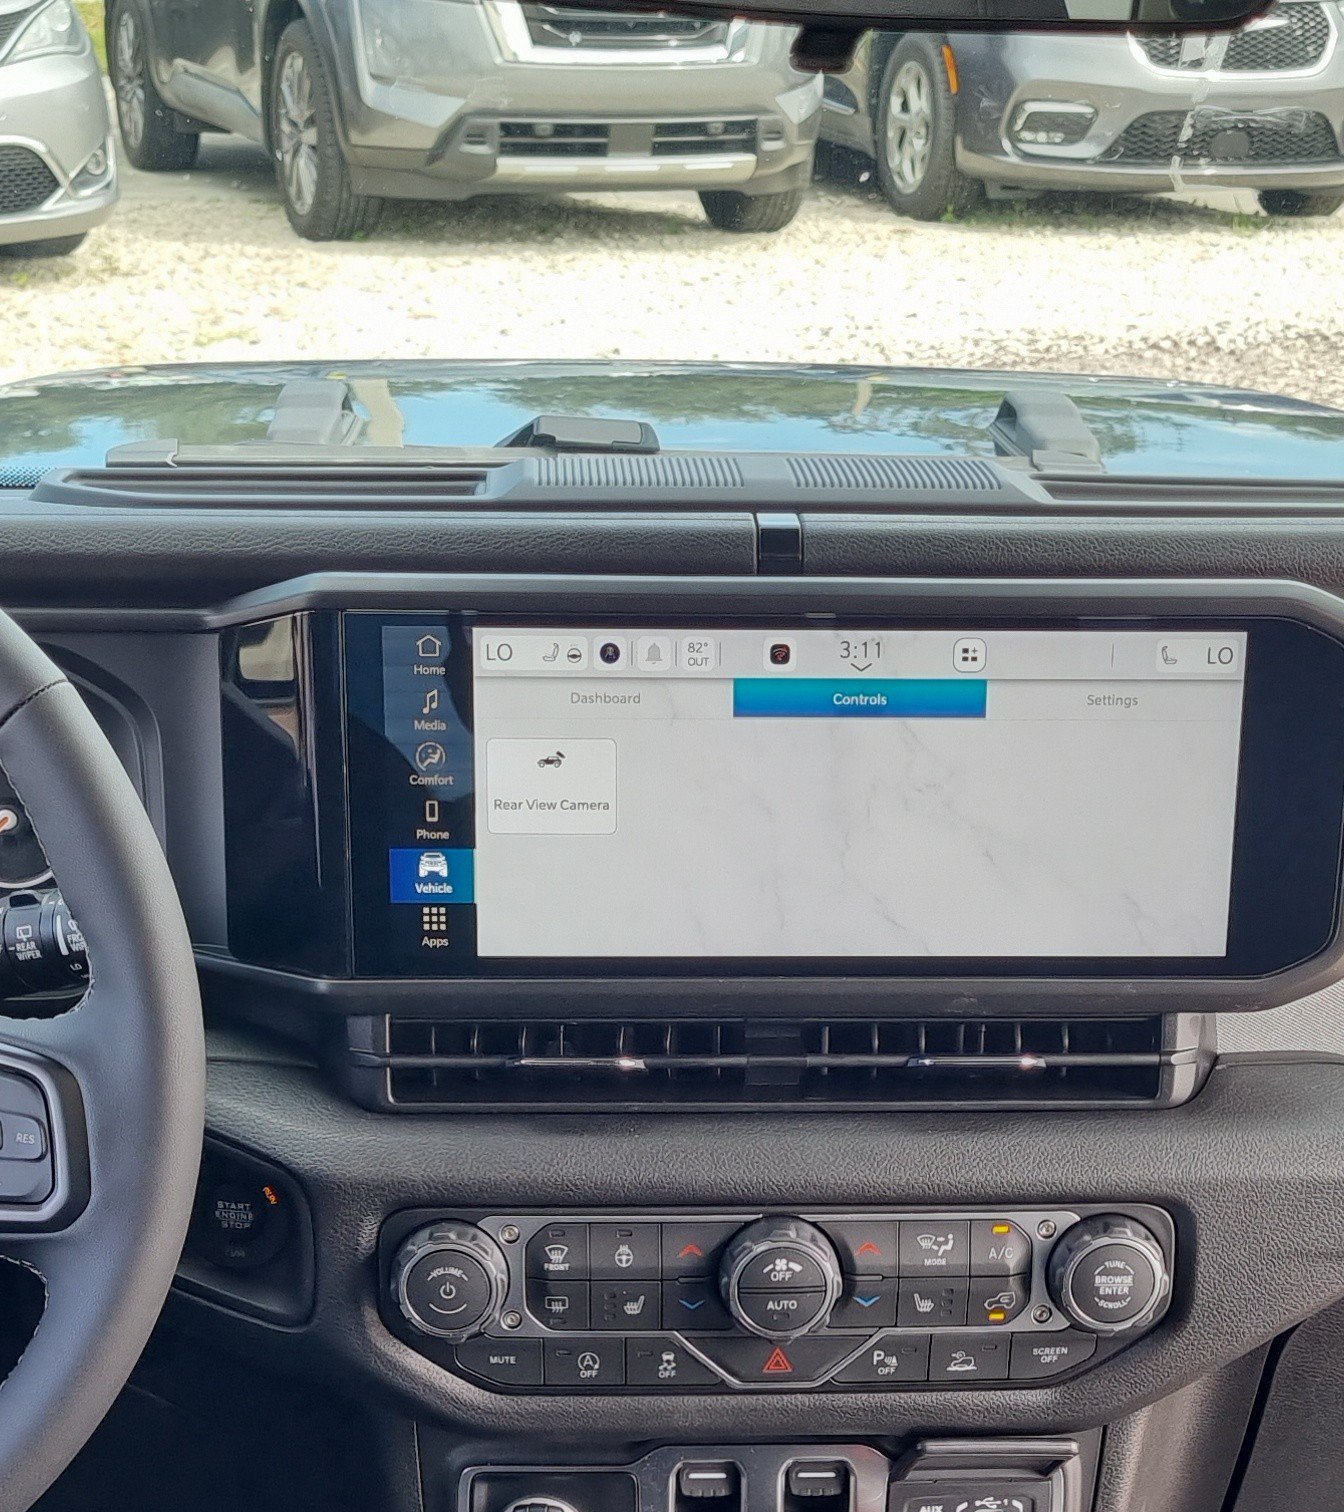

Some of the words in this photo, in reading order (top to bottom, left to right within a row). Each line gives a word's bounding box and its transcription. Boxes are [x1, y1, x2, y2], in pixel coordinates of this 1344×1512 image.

[485, 643, 513, 662] LO
[687, 641, 709, 654] 82°
[839, 640, 884, 660] 3:11
[1206, 646, 1234, 665] LO
[687, 656, 709, 668] OUT
[413, 664, 446, 676] Home
[570, 691, 641, 705] Dashboard
[832, 692, 888, 708] Controls
[1086, 693, 1139, 710] Settings
[414, 719, 446, 731] Media
[409, 774, 454, 787] Comfort
[493, 799, 524, 811] Rear
[526, 799, 558, 811] View
[560, 799, 610, 812] Camera
[416, 828, 449, 841] Phone
[415, 882, 453, 894] Vehicle
[421, 935, 449, 948] Apps
[16, 943, 37, 952] REAR
[17, 951, 43, 961] WIPER
[15, 1132, 35, 1145] RES
[217, 1201, 252, 1210] START
[214, 1211, 254, 1221] ENGINE
[221, 1221, 251, 1229] STOP
[989, 1247, 1014, 1260] A/C
[544, 1263, 570, 1271] FRONT
[924, 1258, 947, 1266] MODE
[1104, 1260, 1126, 1269] TUNE
[770, 1271, 792, 1282] OFF
[1095, 1275, 1134, 1284] BROWSE
[1099, 1286, 1130, 1295] ENTER
[766, 1299, 798, 1311] AUTO
[1098, 1299, 1127, 1309] SCROLL
[1032, 1347, 1068, 1356] SCREEN
[489, 1355, 516, 1365] MUTE
[1040, 1355, 1058, 1363] OFF
[579, 1369, 598, 1379] OFF
[658, 1369, 676, 1379] OFF
[878, 1365, 896, 1375] OFF
